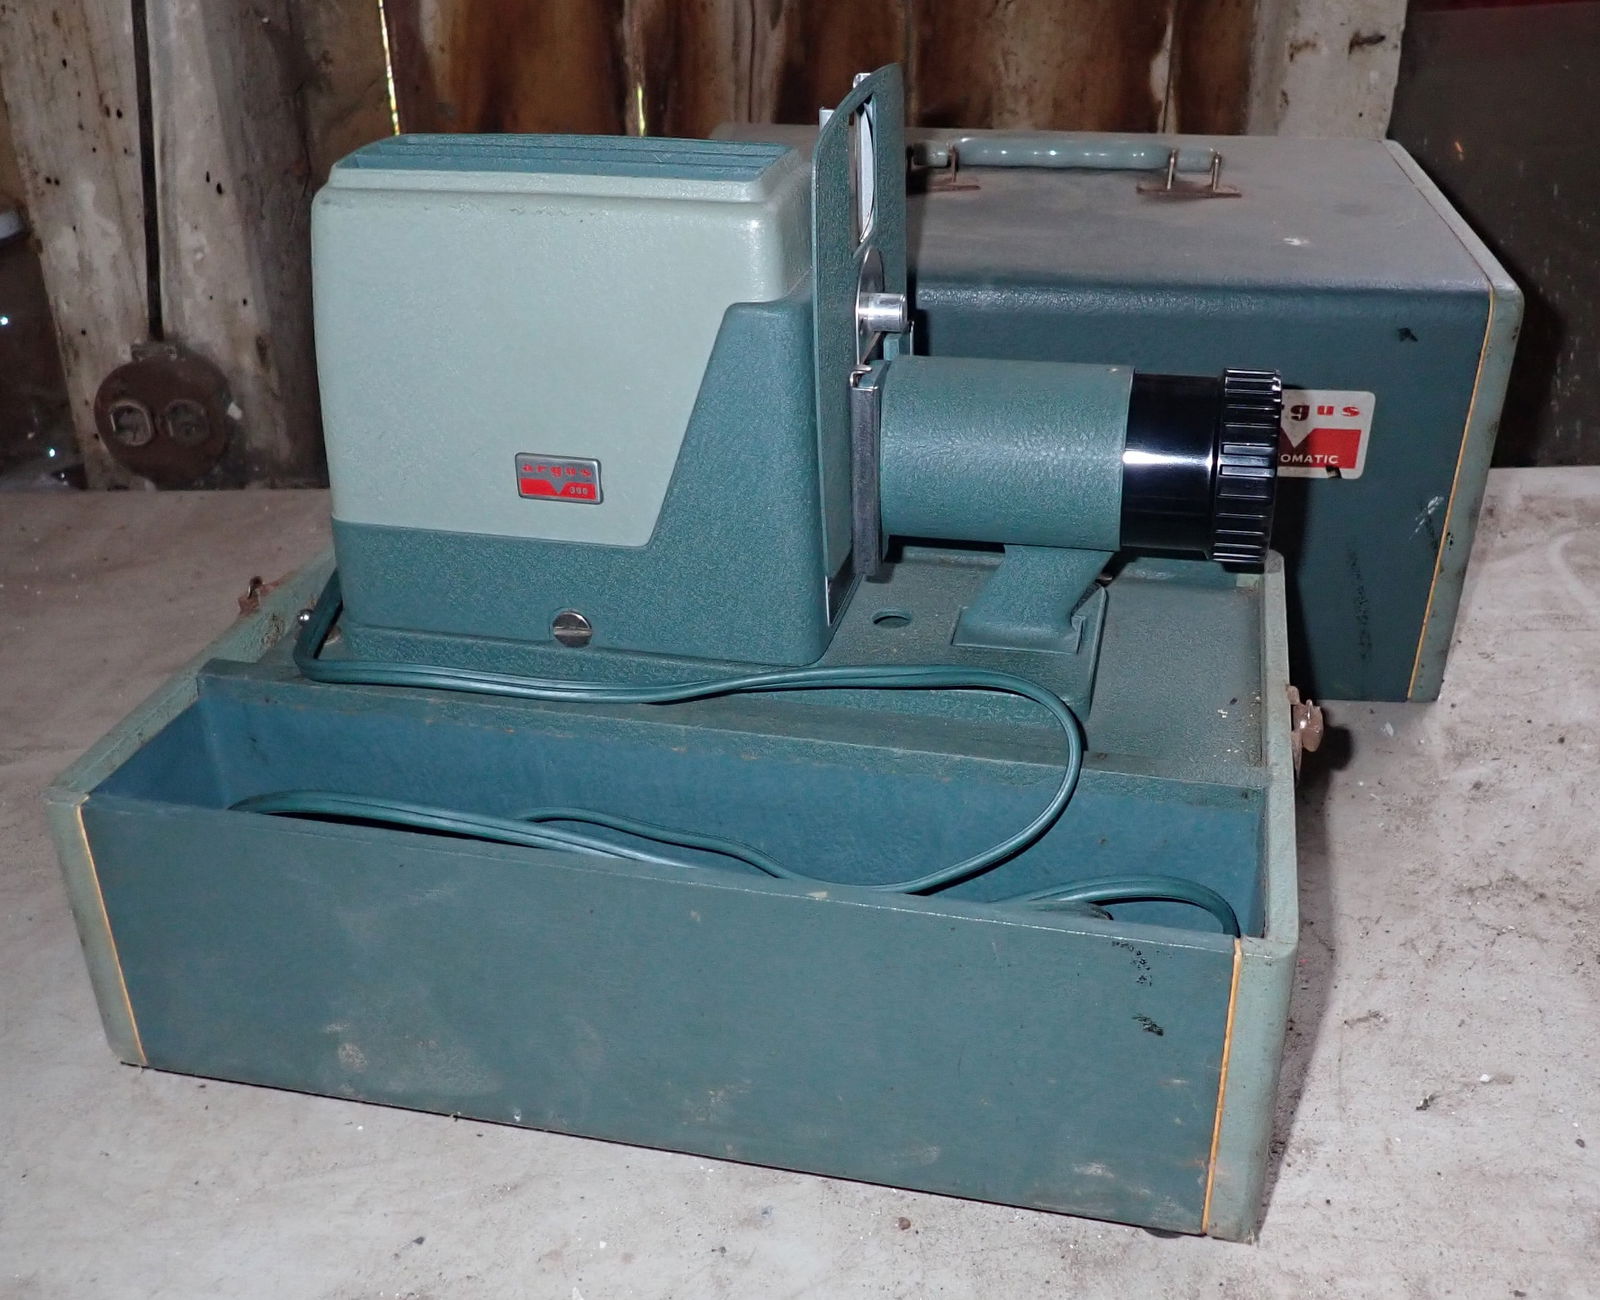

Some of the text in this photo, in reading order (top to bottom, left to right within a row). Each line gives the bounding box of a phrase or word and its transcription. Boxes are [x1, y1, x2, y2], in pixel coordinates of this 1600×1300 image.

[1281, 404, 1360, 422] gus
[522, 464, 592, 478] argus
[570, 486, 589, 495] 300
